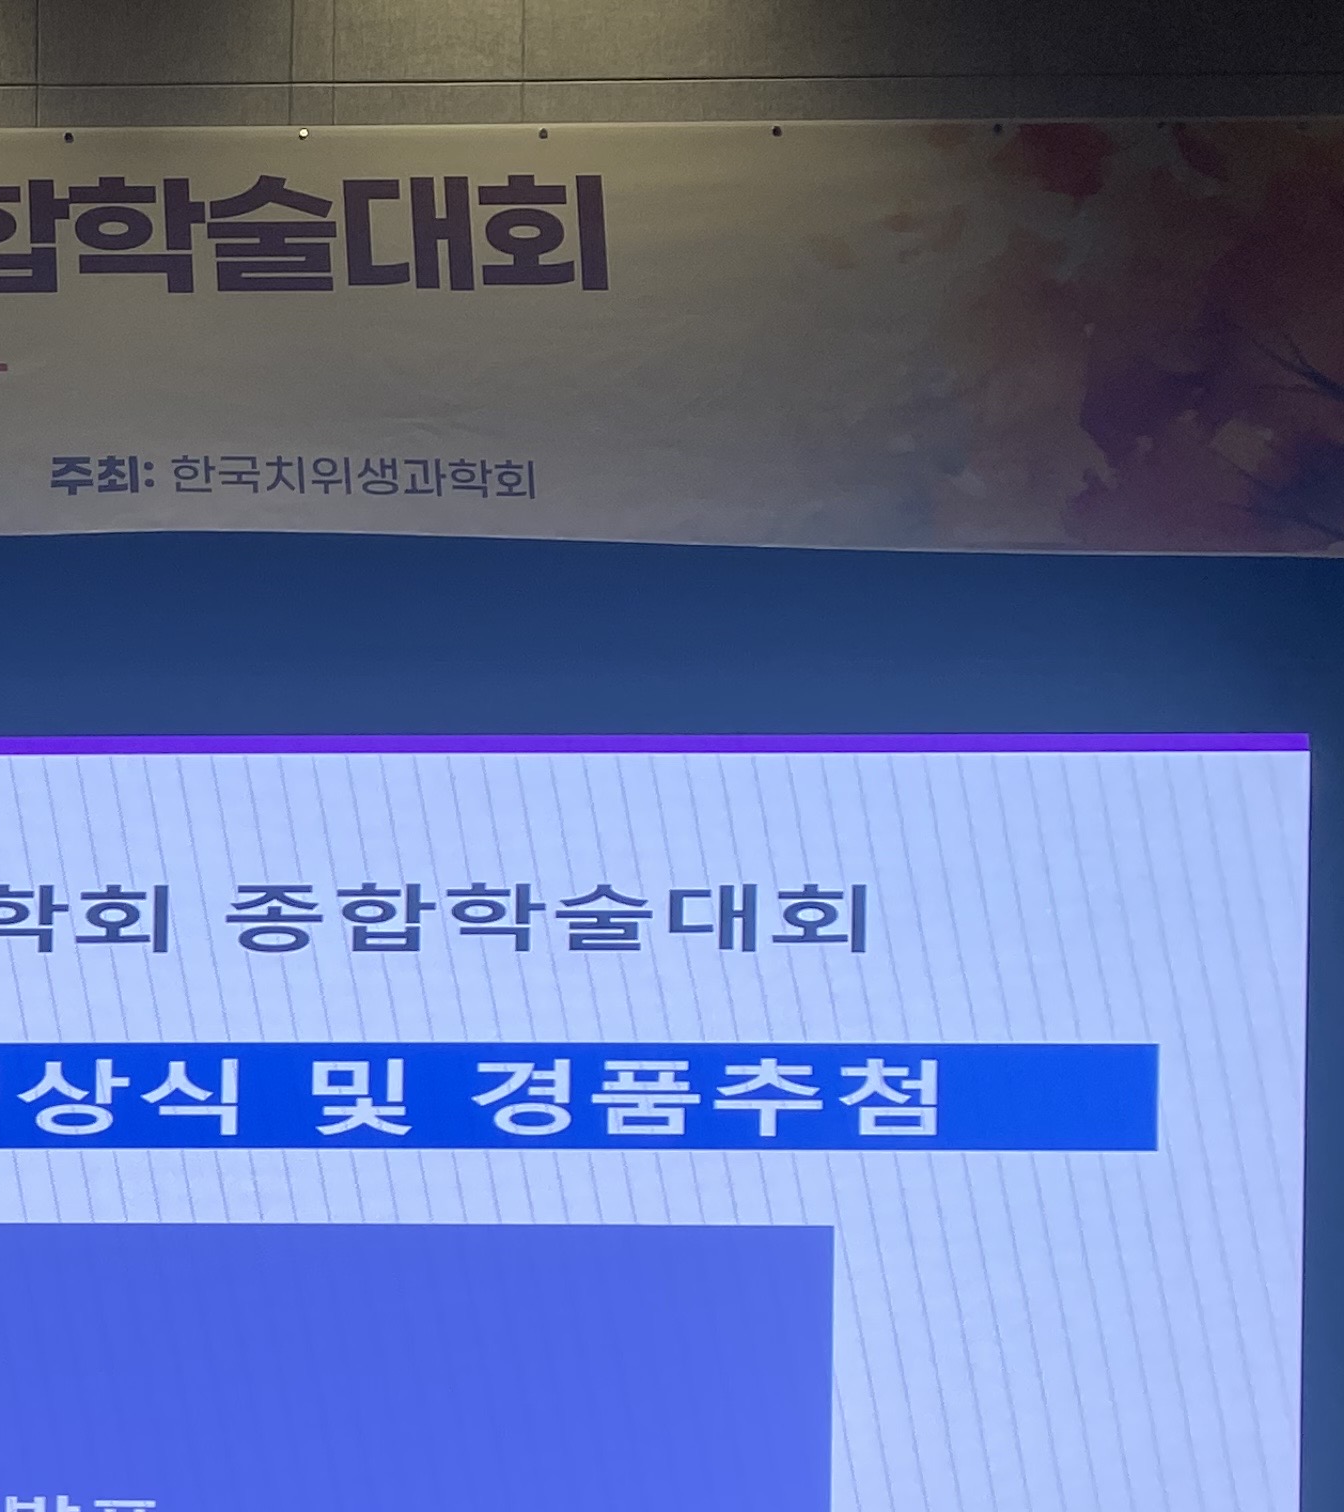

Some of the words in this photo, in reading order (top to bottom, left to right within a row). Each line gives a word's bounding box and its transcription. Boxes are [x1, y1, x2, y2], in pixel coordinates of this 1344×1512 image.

[51, 456, 154, 495] 주최:
[172, 455, 535, 499] 한국치위생과학회
[226, 883, 865, 952] 종합학술대회
[312, 1059, 411, 1135] 및
[472, 1059, 937, 1136] 경품추첨
